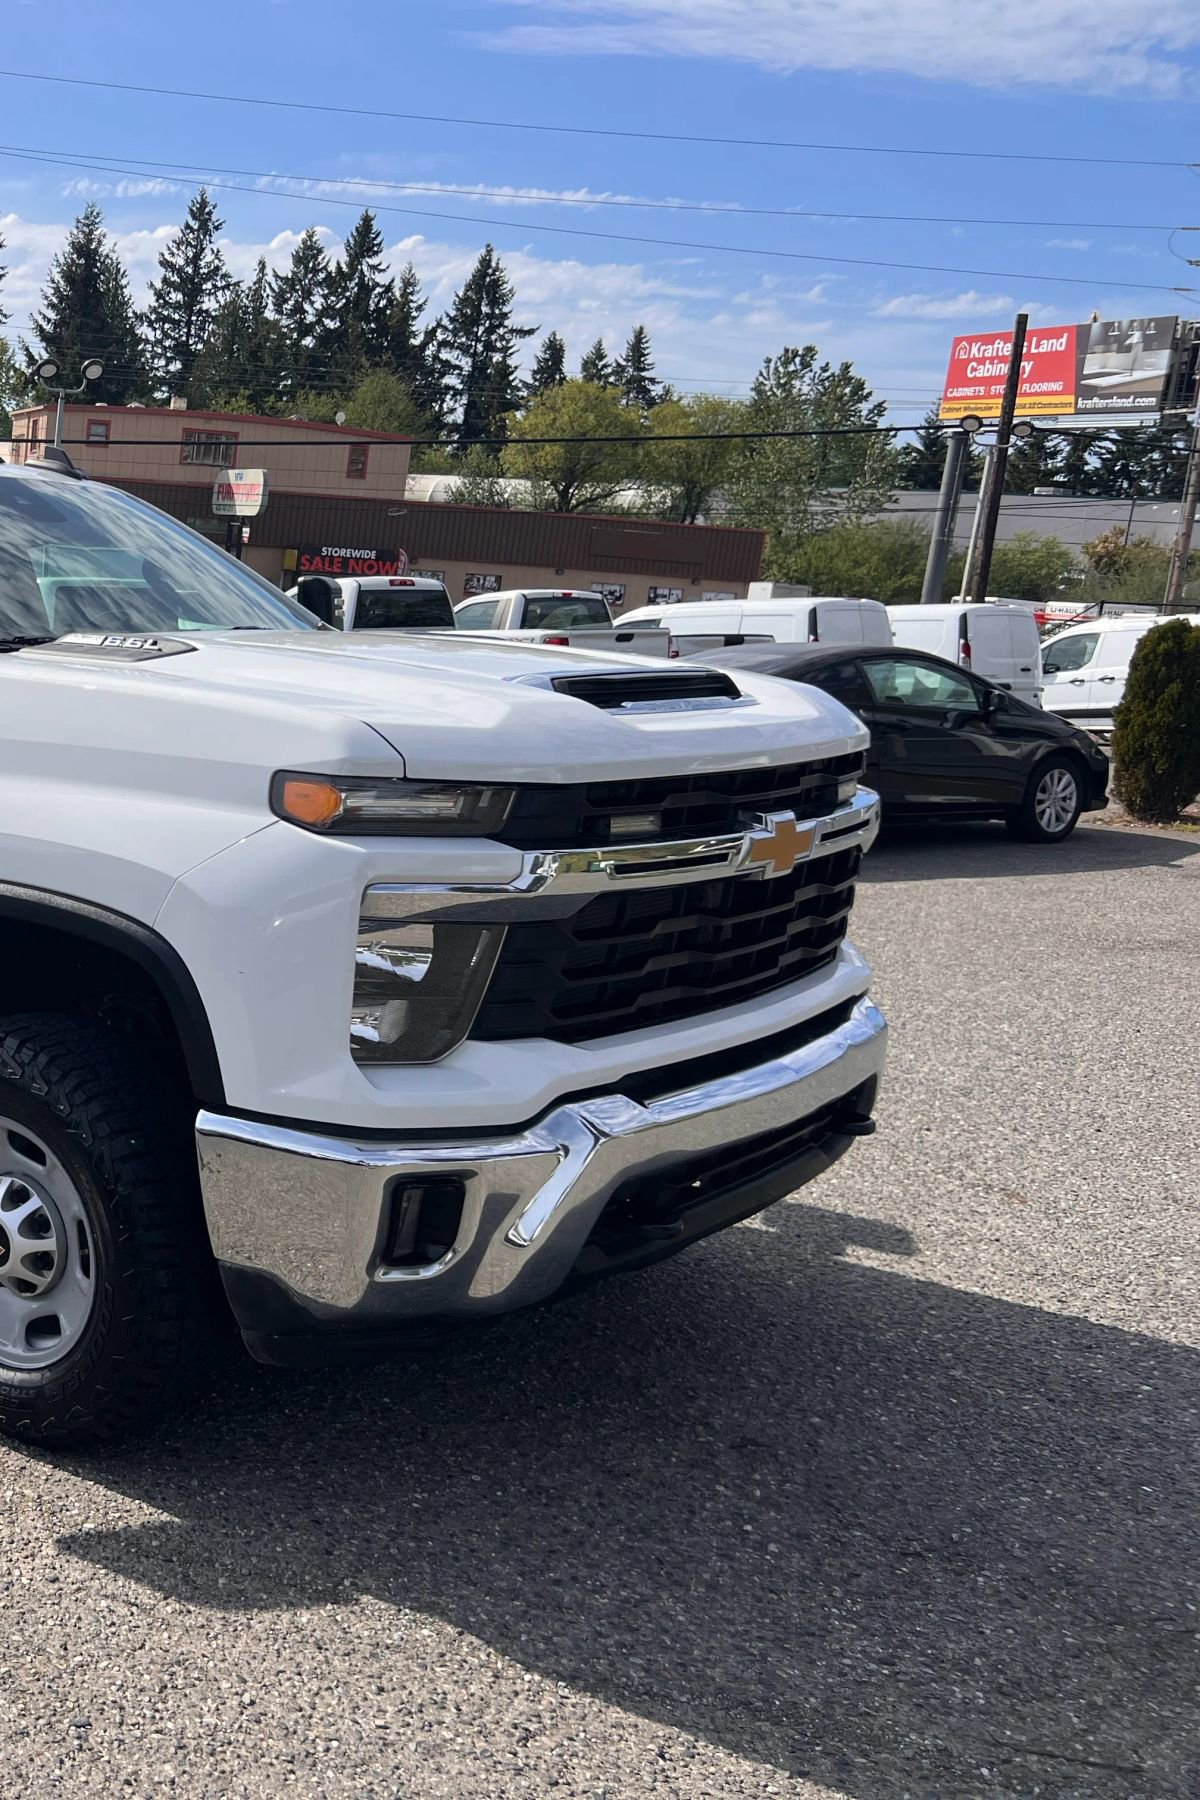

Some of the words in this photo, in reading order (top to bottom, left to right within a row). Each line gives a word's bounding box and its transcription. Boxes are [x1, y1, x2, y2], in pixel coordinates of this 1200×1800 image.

[969, 338, 1028, 359] Kraftes
[1030, 332, 1068, 353] Land
[966, 359, 1035, 379] Cabinry
[946, 386, 985, 398] CABINETS
[1021, 381, 1064, 394] FLOORING
[1077, 395, 1157, 409] kraftersland.com
[321, 546, 377, 560] STOREWIDE
[300, 554, 342, 573] SALE
[348, 558, 399, 577] NOW
[1050, 607, 1079, 615] U-HAUL
[102, 636, 159, 650] 6.6L
